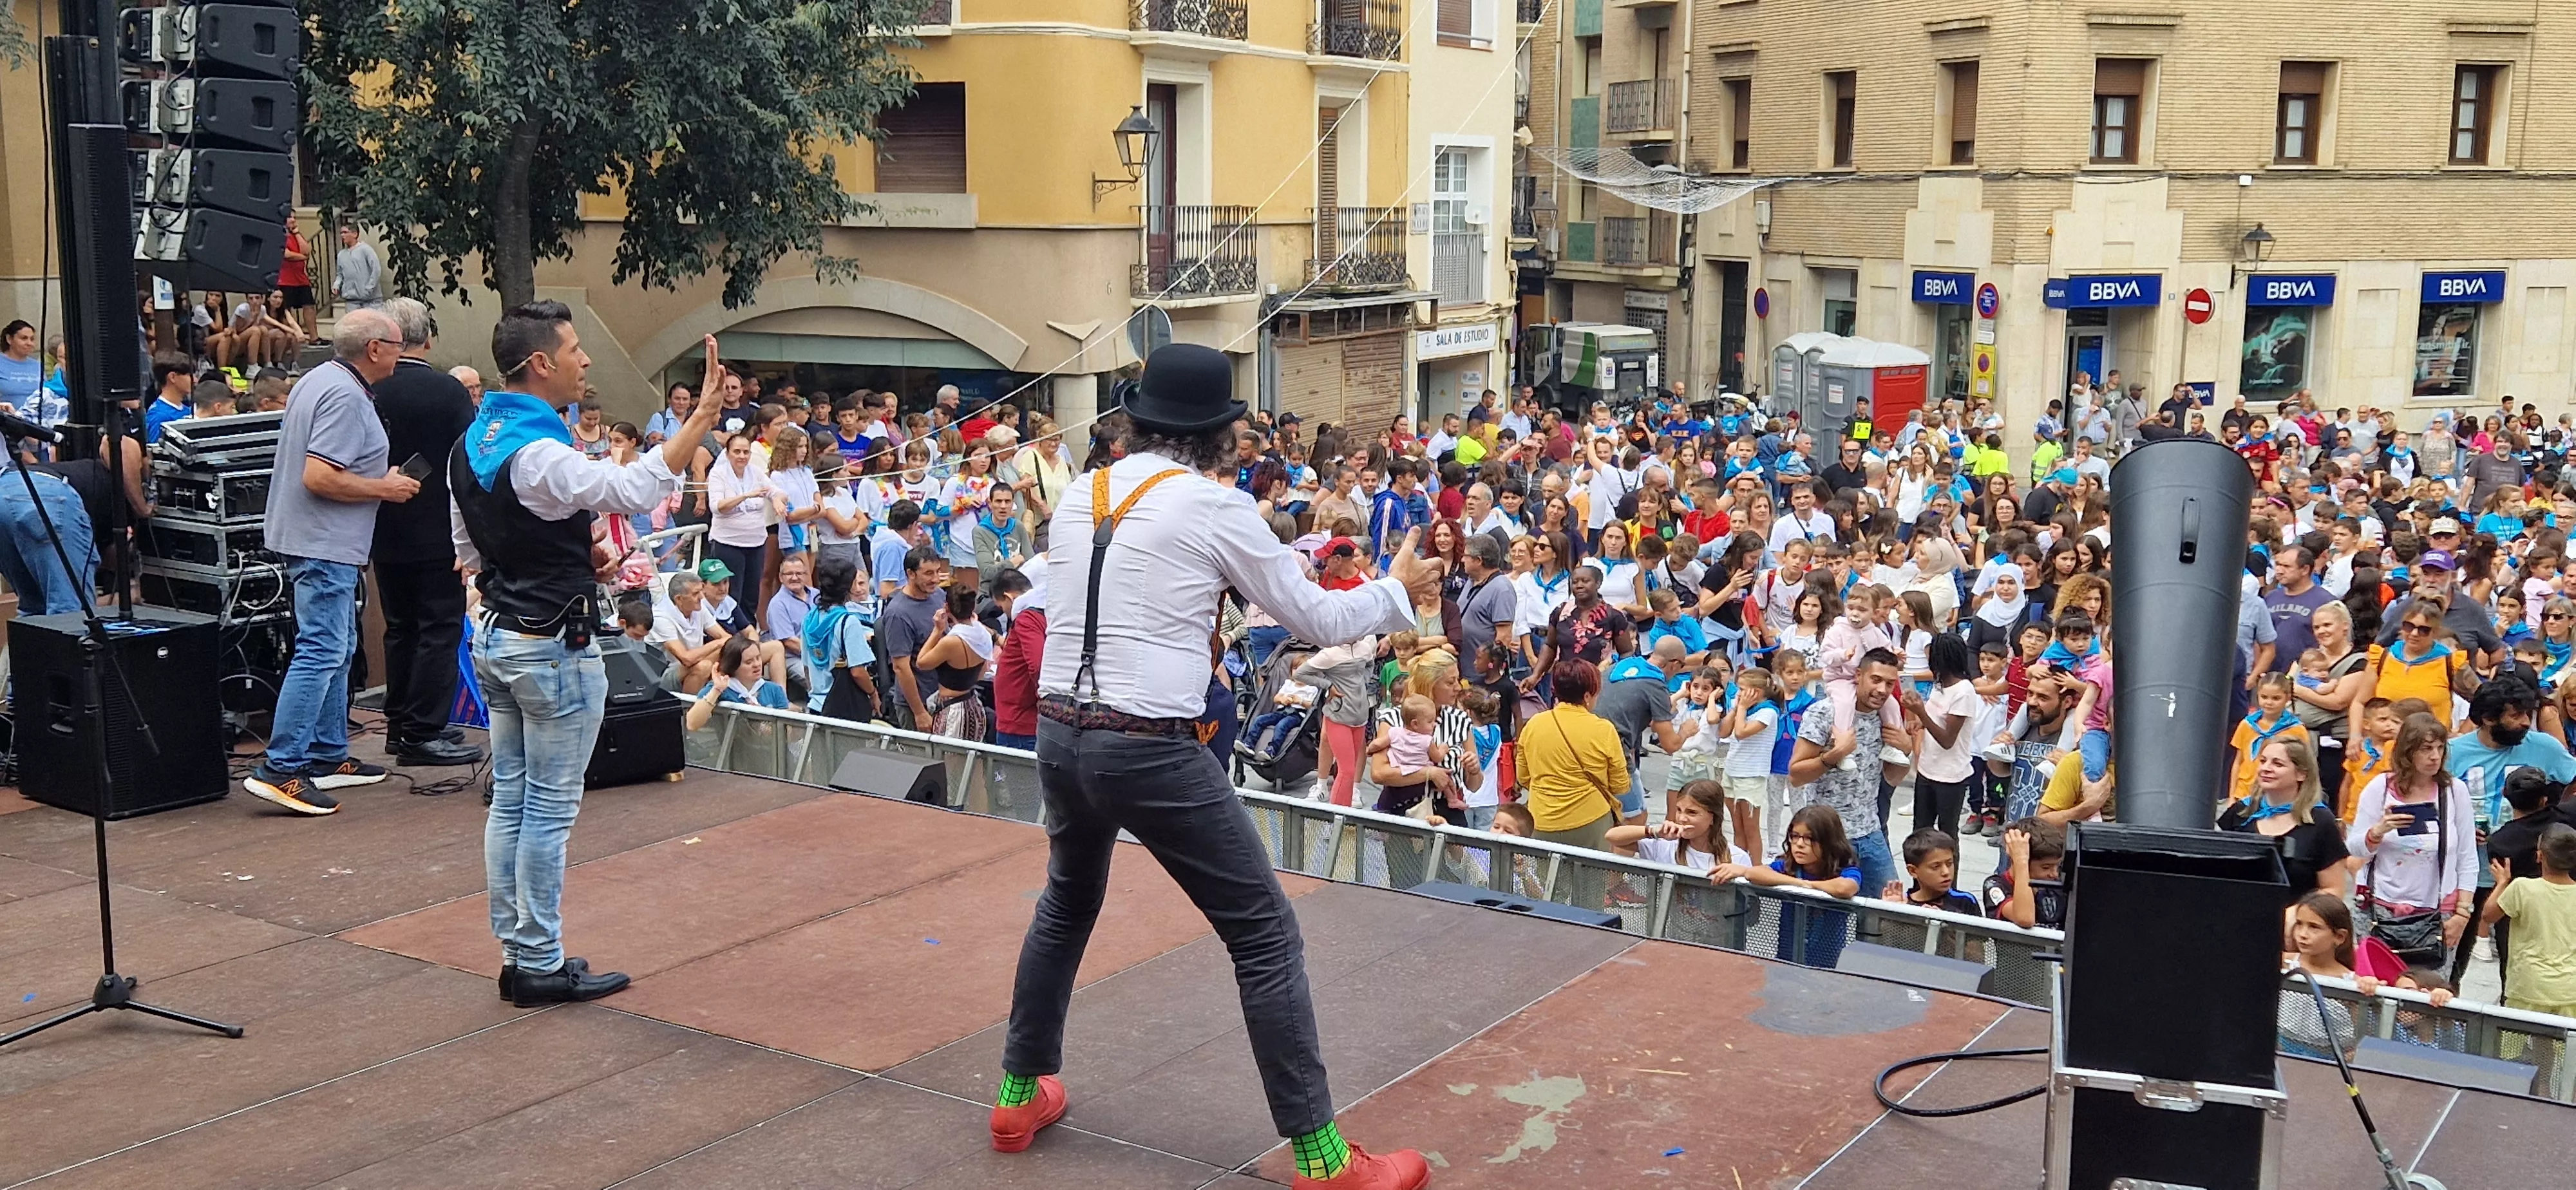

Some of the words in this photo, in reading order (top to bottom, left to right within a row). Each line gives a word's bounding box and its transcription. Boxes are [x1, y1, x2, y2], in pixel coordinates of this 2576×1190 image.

[1924, 278, 1958, 296] BBVA
[2049, 289, 2066, 298] BBVA
[2089, 280, 2141, 301] BBVA
[2266, 280, 2316, 299] BBVA
[2439, 278, 2486, 296] BBVA
[1436, 332, 1452, 346] SALA
[1454, 330, 1463, 344] DE
[1463, 328, 1490, 343] ESTUDIO
